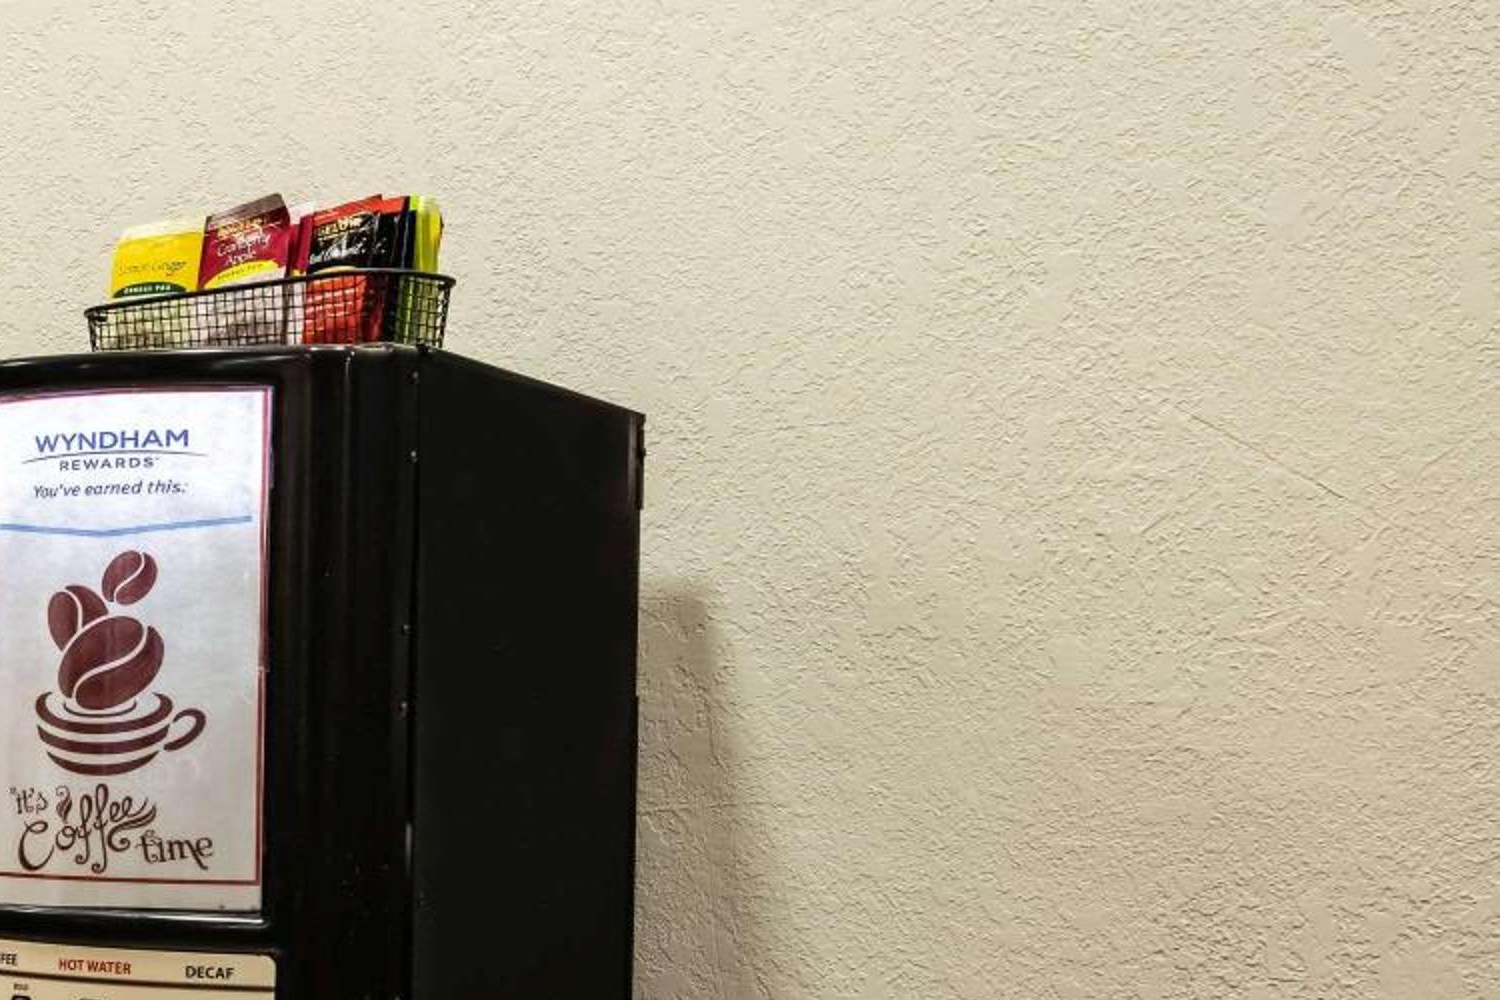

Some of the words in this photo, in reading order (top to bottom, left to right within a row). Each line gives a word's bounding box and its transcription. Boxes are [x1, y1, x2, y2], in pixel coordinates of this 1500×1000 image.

[35, 428, 190, 453] WYNDHAM
[59, 456, 154, 471] REWARDS
[33, 482, 80, 499] You've
[84, 480, 142, 496] earned
[17, 783, 157, 874] Coffee
[132, 830, 215, 871] time
[58, 958, 85, 972] HOT
[87, 960, 132, 975] WATER
[185, 965, 235, 980] DECAF
